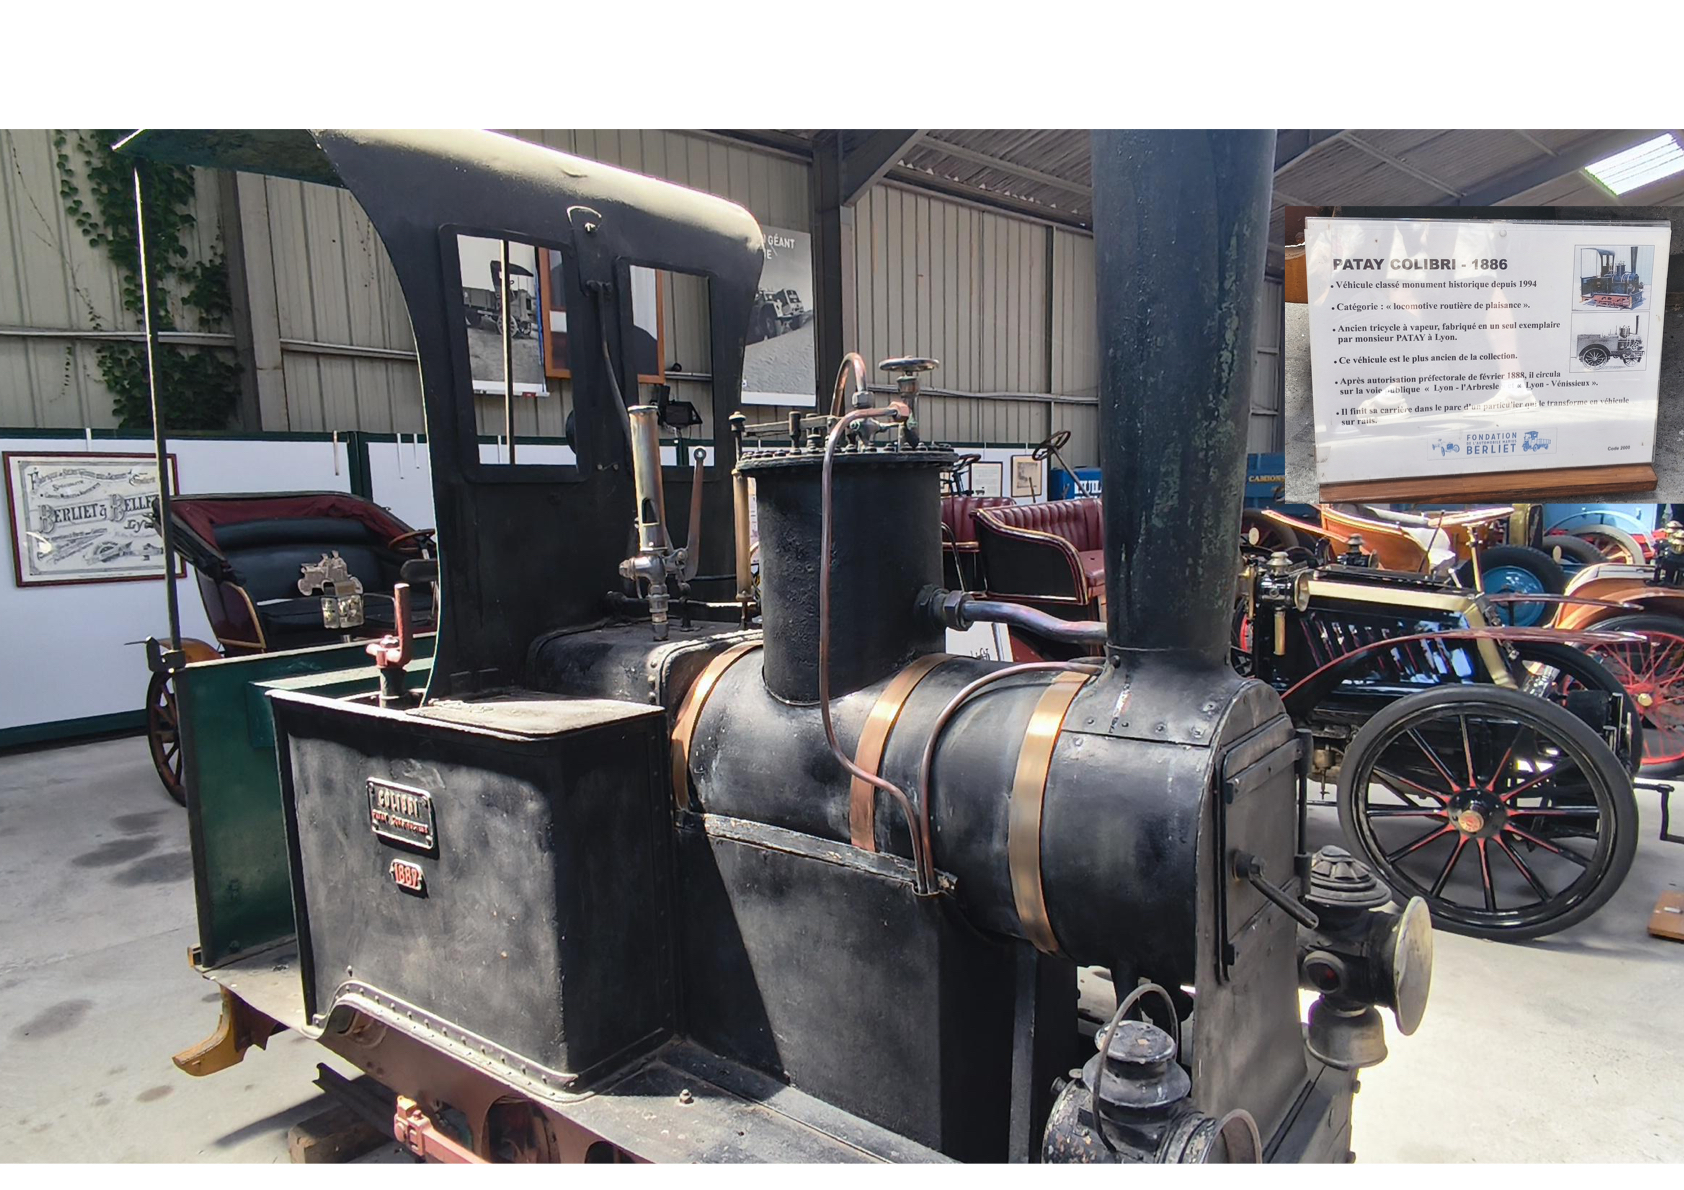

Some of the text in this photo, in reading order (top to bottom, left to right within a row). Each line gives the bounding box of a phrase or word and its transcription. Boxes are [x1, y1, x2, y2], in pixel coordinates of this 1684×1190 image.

[768, 233, 795, 250] GÉANT
[1333, 258, 1384, 270] PATAY
[1390, 258, 1456, 270] COLIBRI
[1472, 258, 1508, 270] 1886
[1336, 280, 1373, 289] Véhicule
[1375, 280, 1400, 288] classé
[1448, 280, 1489, 290] historique
[1491, 280, 1516, 290] depuis
[1336, 302, 1378, 312] Catégorie
[1486, 302, 1521, 310] plaisance
[1370, 324, 1400, 333] tricycle
[1410, 324, 1440, 332] vapeur,
[1442, 322, 1476, 332] fabriqué
[1519, 321, 1560, 330] exemplaire
[1355, 335, 1394, 343] monsieur
[1435, 334, 1457, 342] Lyon.
[1353, 356, 1387, 364] véhicule
[1412, 355, 1429, 364] plus
[1480, 352, 1518, 360] collection.
[1340, 377, 1365, 386] Après
[1367, 376, 1416, 384] autorisation
[1418, 374, 1466, 384] préfectorale
[1380, 406, 1412, 414] carrière
[1467, 432, 1517, 441] FONDATION
[1466, 444, 1516, 455] BERLIET
[38, 504, 98, 533] BERLIET
